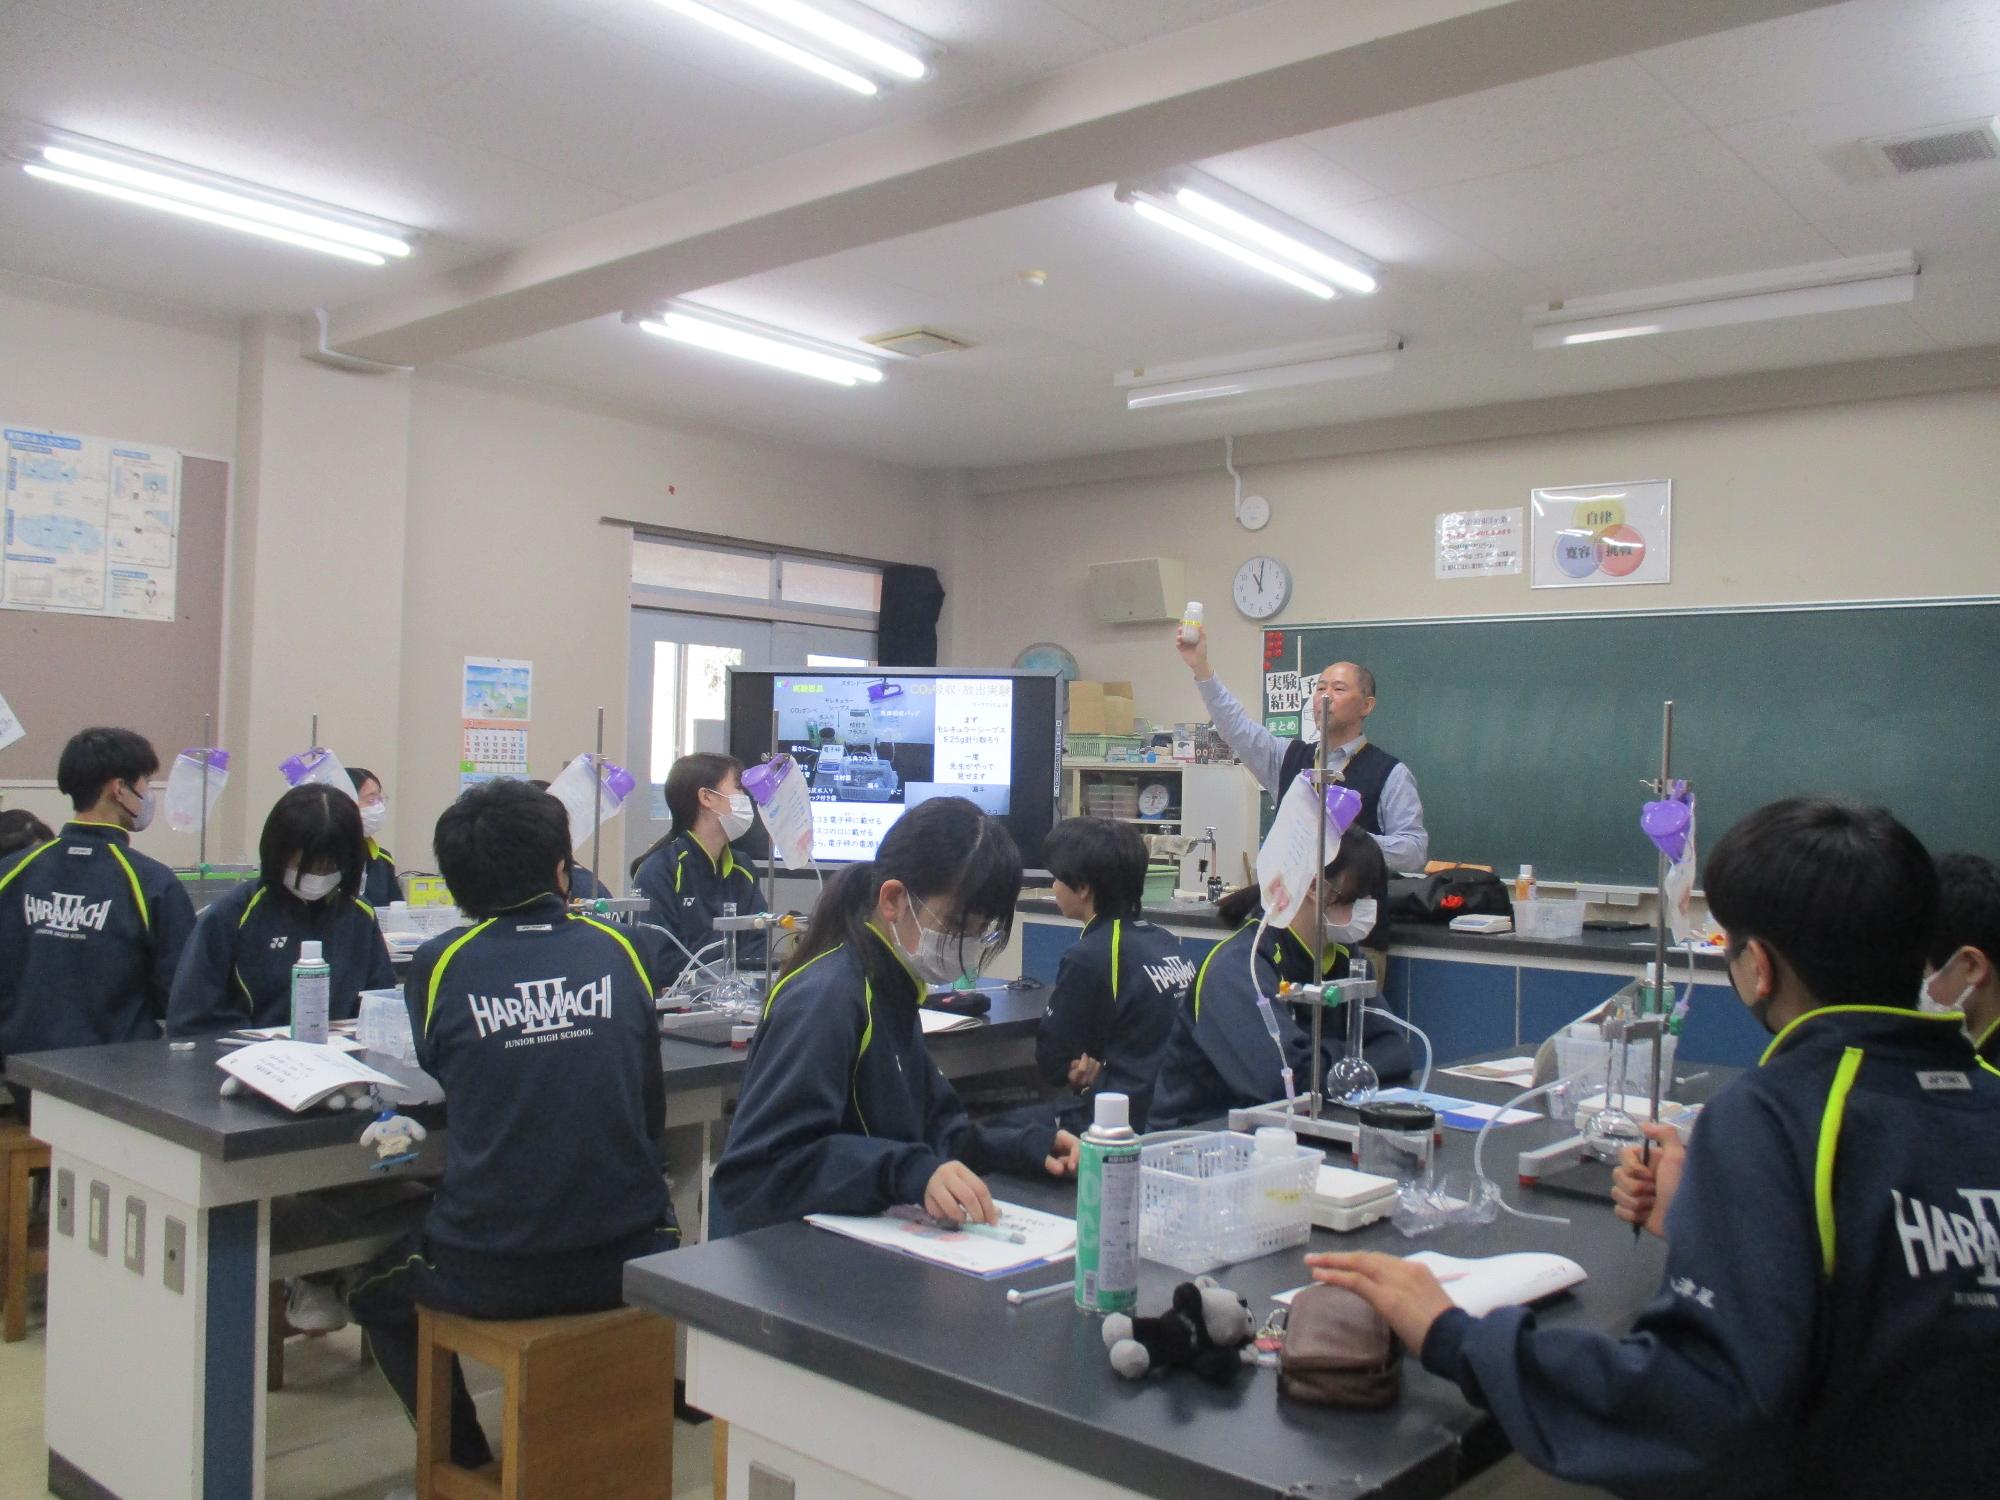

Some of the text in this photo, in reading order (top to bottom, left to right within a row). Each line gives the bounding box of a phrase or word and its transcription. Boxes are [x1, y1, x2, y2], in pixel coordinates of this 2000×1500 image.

[1586, 510, 1612, 525] 自律
[1566, 546, 1590, 559] 寛容
[1267, 673, 1297, 691] 実験
[1270, 693, 1299, 710] 結果
[1268, 720, 1296, 732] まとめ
[24, 893, 112, 931] HARAMACHI
[467, 974, 612, 1040] HARAMACHI
[504, 1028, 594, 1049] JUNIOR HIGH SCHOOL
